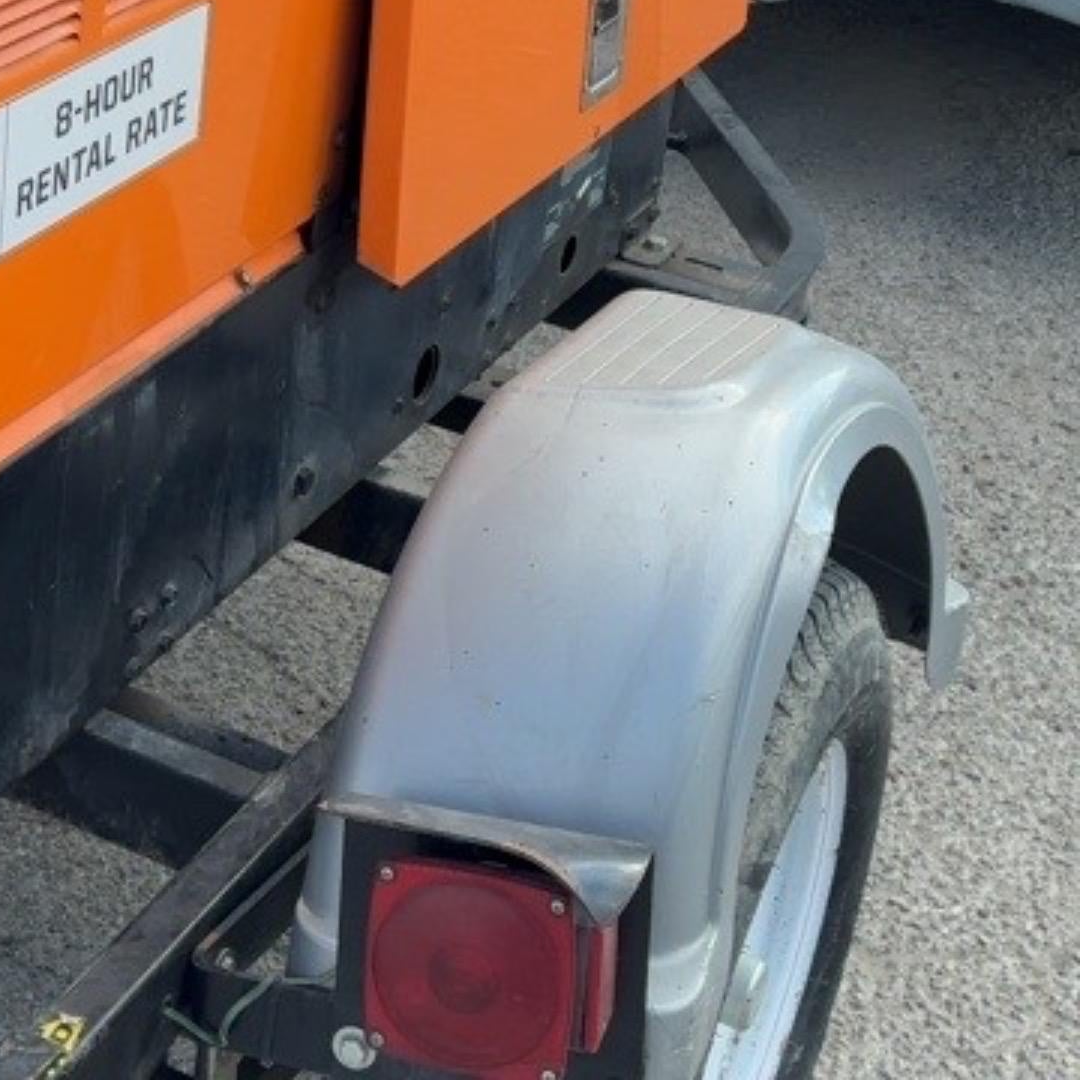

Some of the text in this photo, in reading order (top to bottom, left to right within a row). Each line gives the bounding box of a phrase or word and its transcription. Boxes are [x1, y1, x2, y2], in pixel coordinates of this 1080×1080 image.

[54, 55, 155, 139] 8-HOUR
[15, 89, 189, 218] RENTAL RATE
